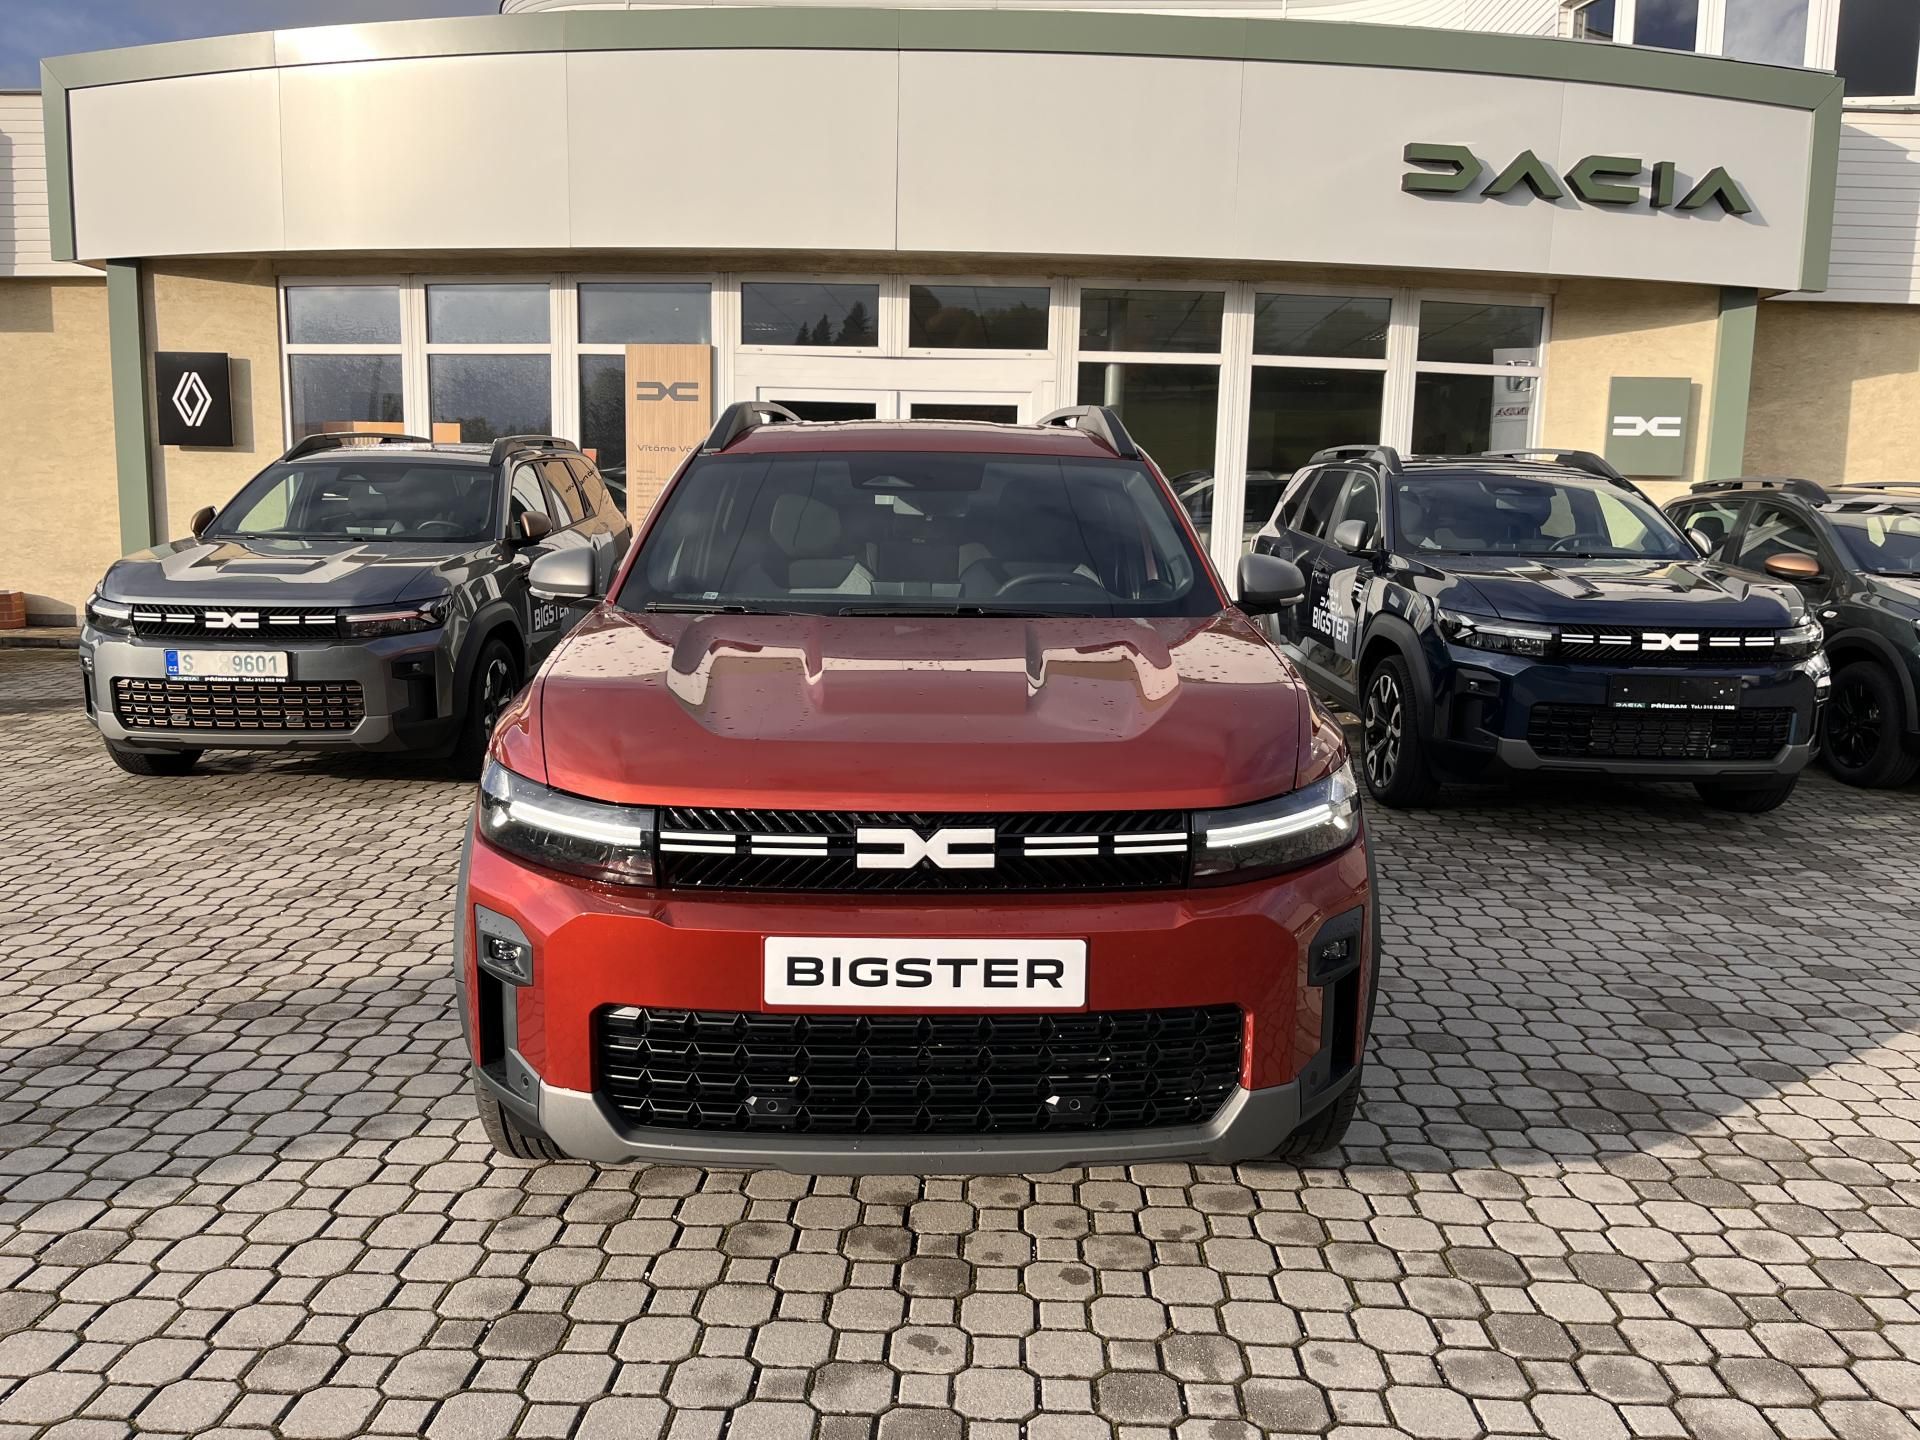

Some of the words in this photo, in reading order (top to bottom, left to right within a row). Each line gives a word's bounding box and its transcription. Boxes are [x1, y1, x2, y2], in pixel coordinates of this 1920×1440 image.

[1402, 143, 1752, 215] DACIA
[1312, 606, 1349, 644] BIGSTER
[786, 957, 1064, 988] BIGSTER
